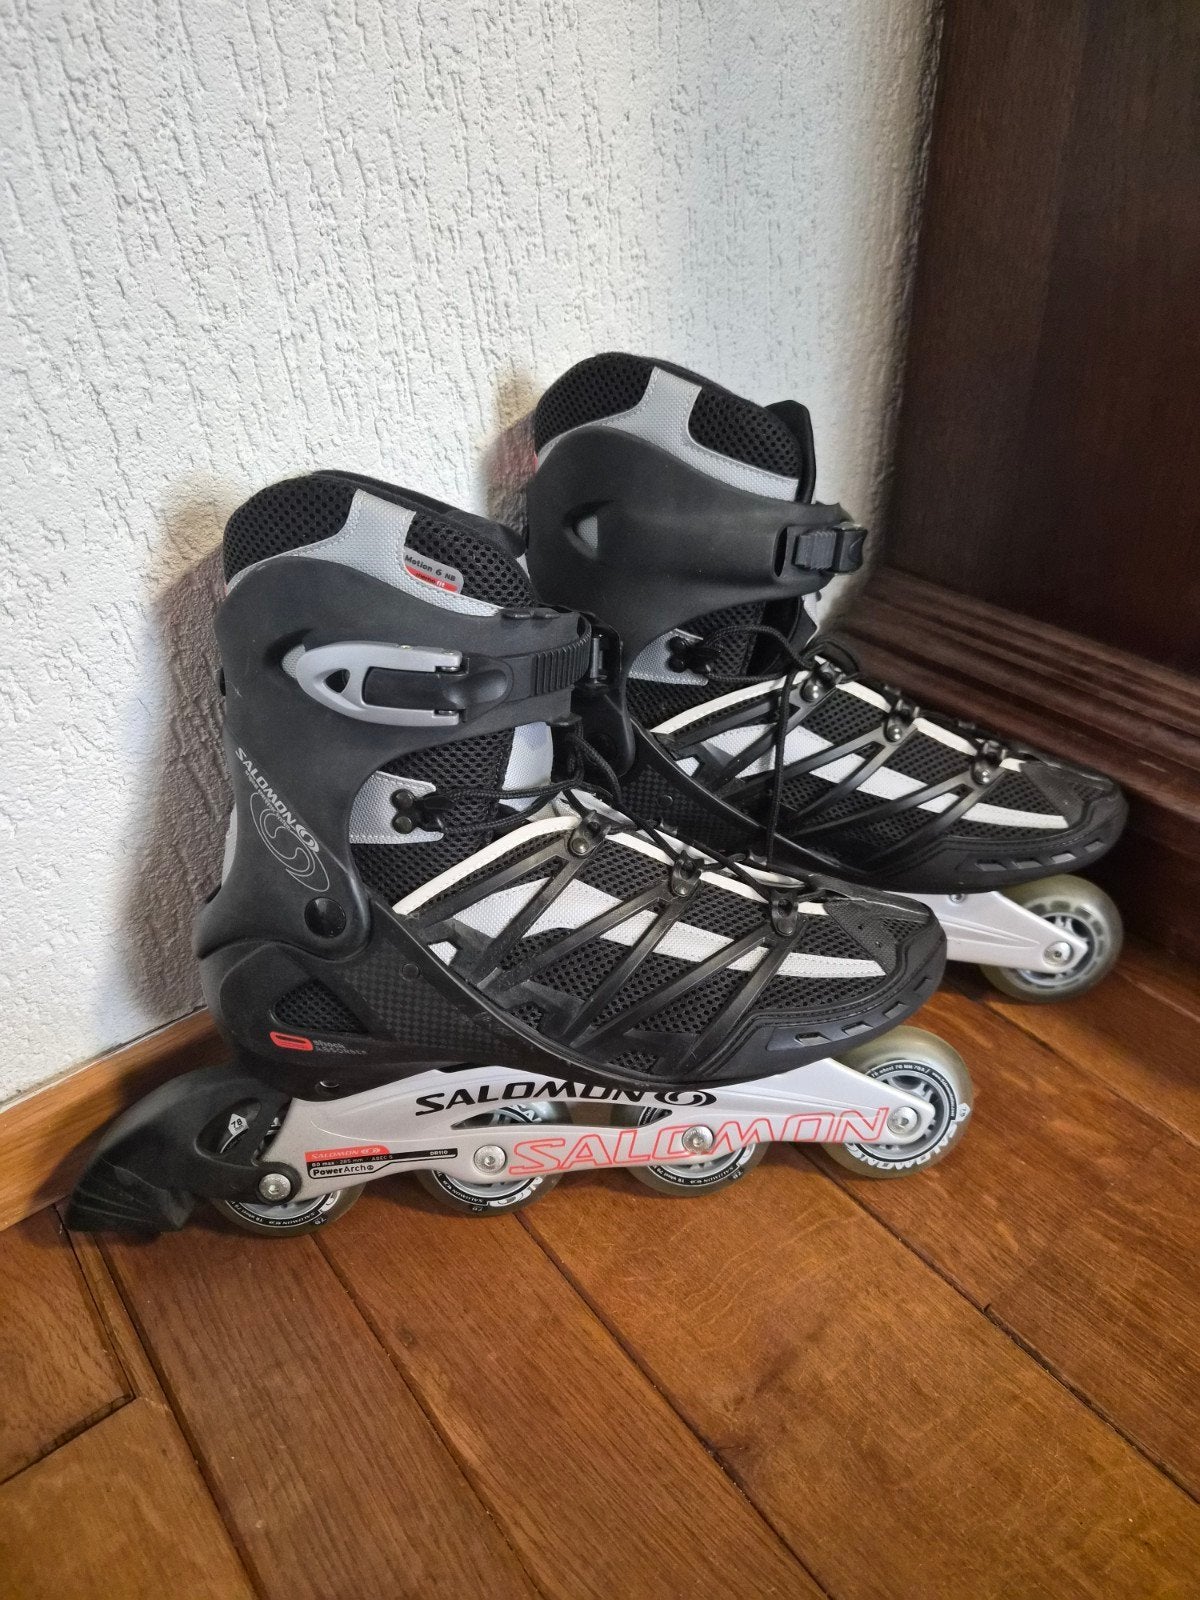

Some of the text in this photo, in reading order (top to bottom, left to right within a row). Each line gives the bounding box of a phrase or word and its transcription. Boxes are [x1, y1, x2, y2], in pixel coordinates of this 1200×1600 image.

[405, 554, 456, 581] Motion 6 NB
[235, 747, 296, 825] SALOMON
[415, 1081, 648, 1117] SALOMON
[231, 1118, 243, 1128] 78
[509, 1107, 889, 1175] SALOMON
[311, 1150, 360, 1160] SALOMON
[313, 1164, 366, 1177] PowerArch
